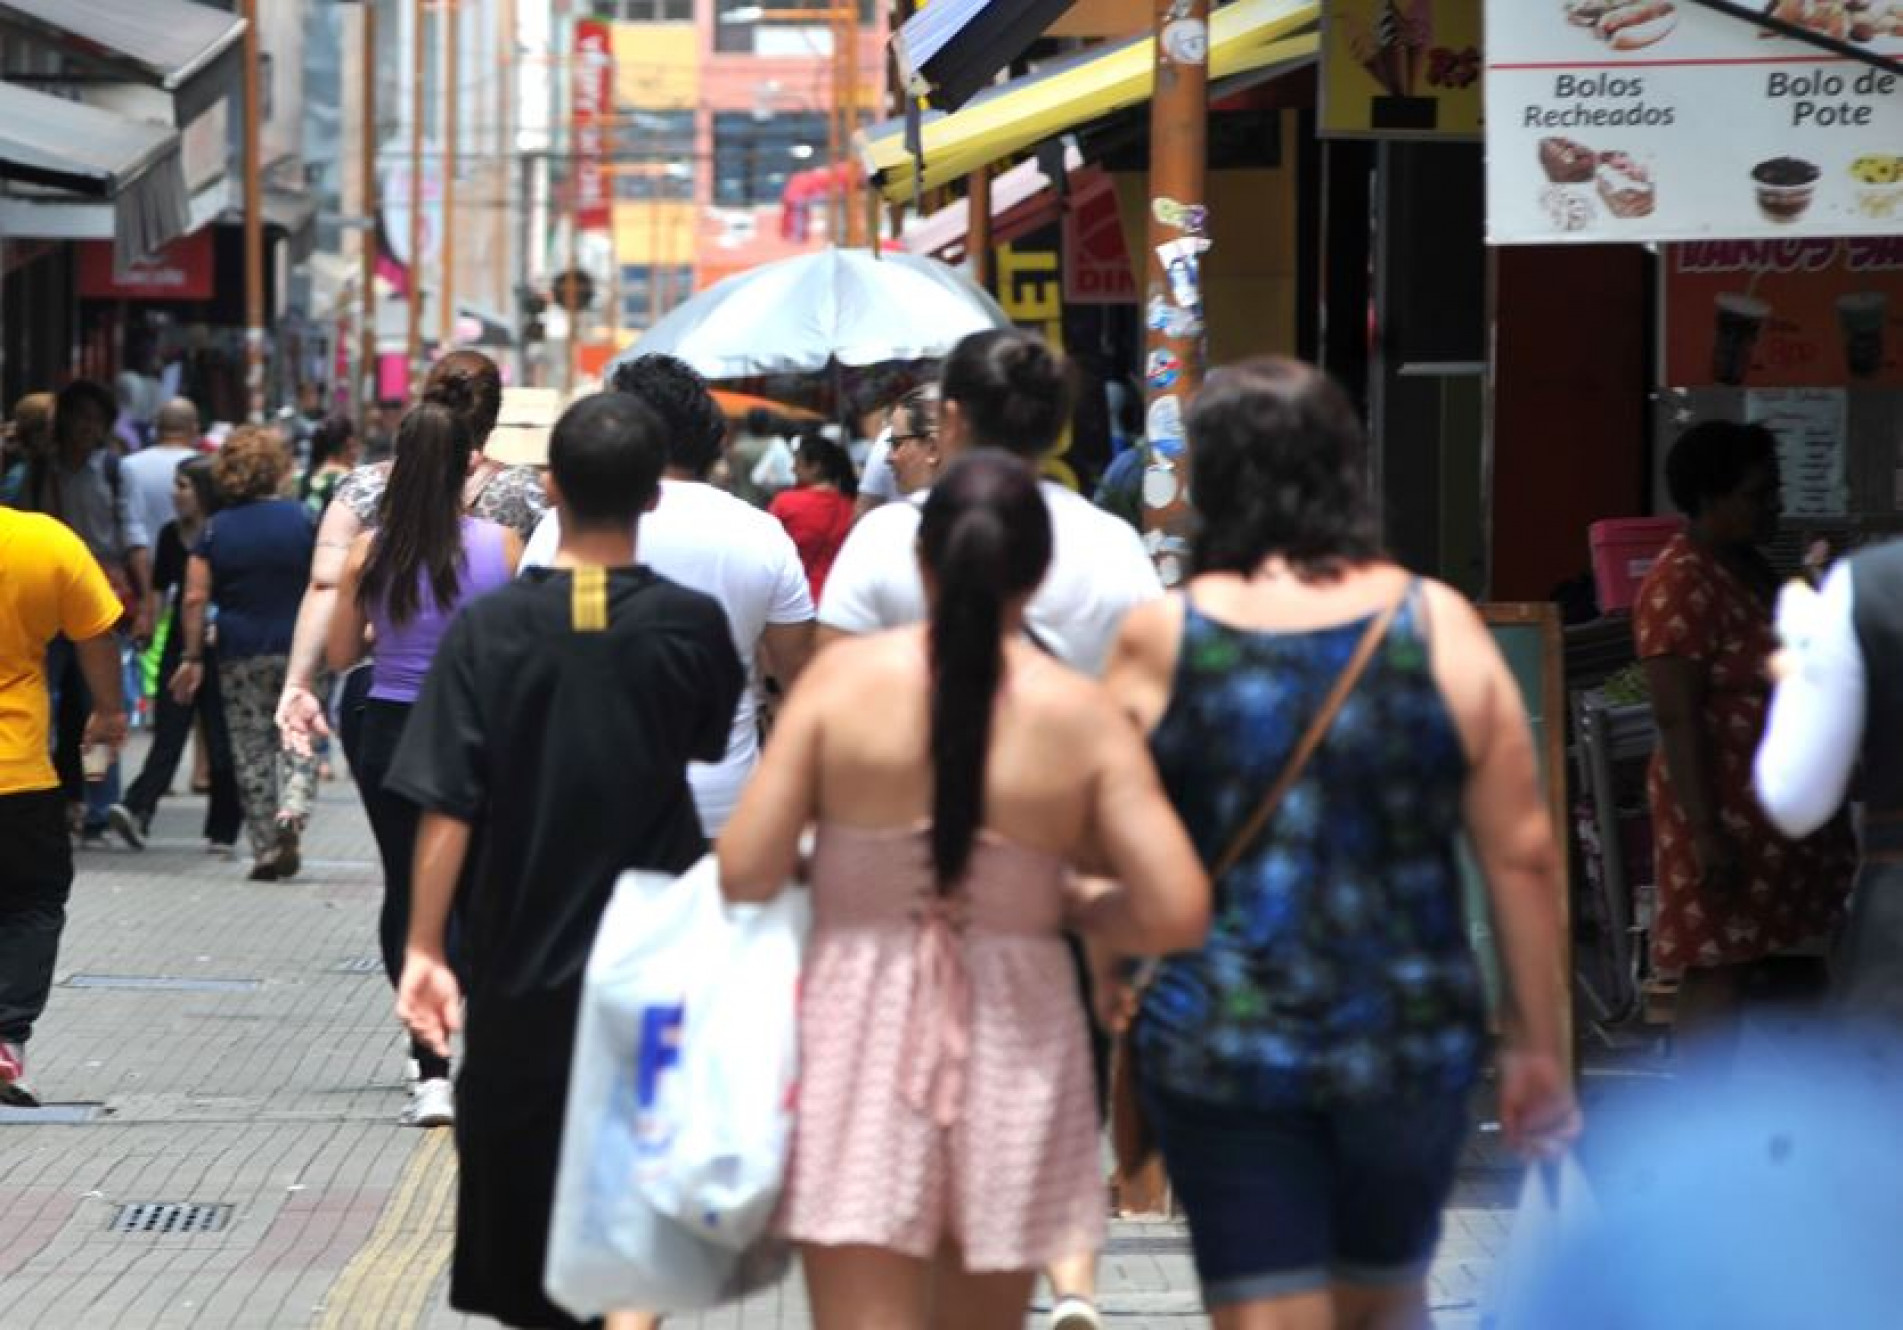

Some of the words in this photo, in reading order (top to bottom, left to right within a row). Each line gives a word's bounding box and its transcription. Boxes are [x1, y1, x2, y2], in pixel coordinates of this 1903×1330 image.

[1555, 74, 1644, 98] Bolos
[1766, 71, 1844, 97] Bolo
[1853, 67, 1896, 95] de
[1523, 103, 1676, 127] Recheados
[1792, 101, 1874, 126] Pote
